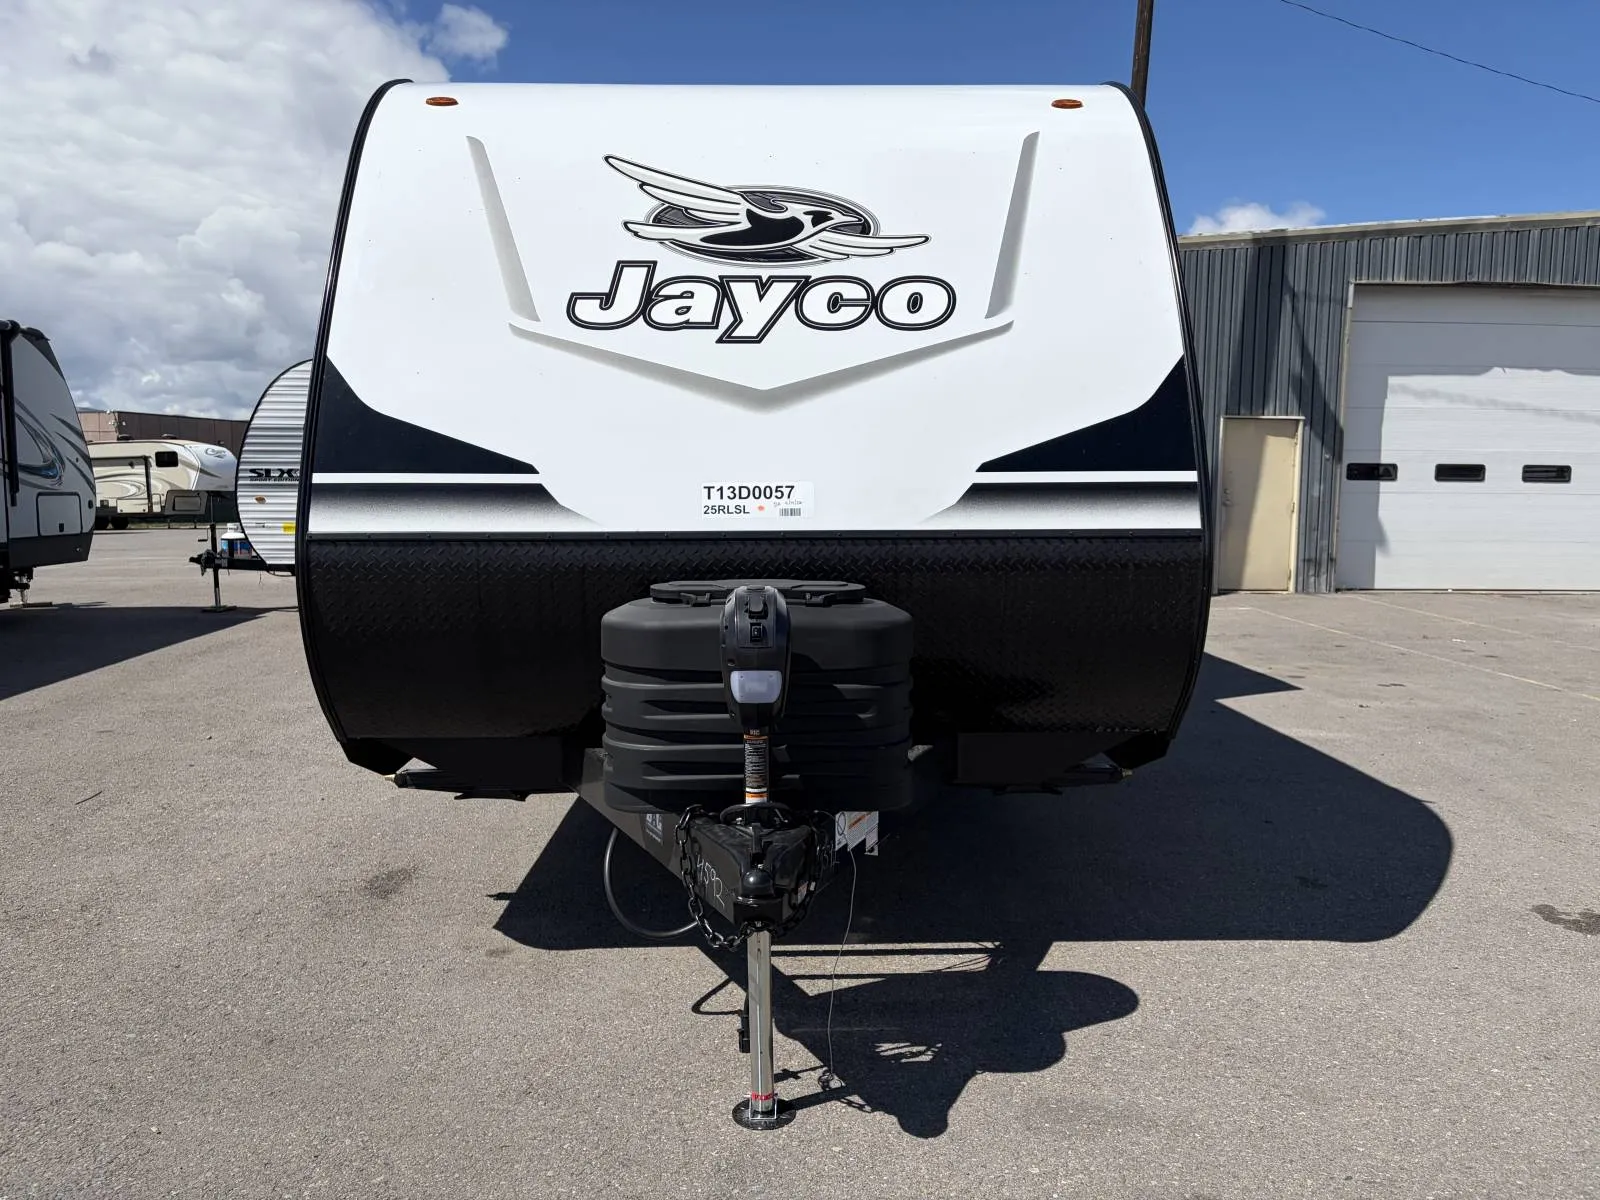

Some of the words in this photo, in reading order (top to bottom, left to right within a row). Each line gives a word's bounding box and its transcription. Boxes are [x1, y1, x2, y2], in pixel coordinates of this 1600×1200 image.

[567, 260, 956, 344] Jayco
[703, 485, 795, 500] T13D0057
[703, 504, 750, 515] 25RLSL
